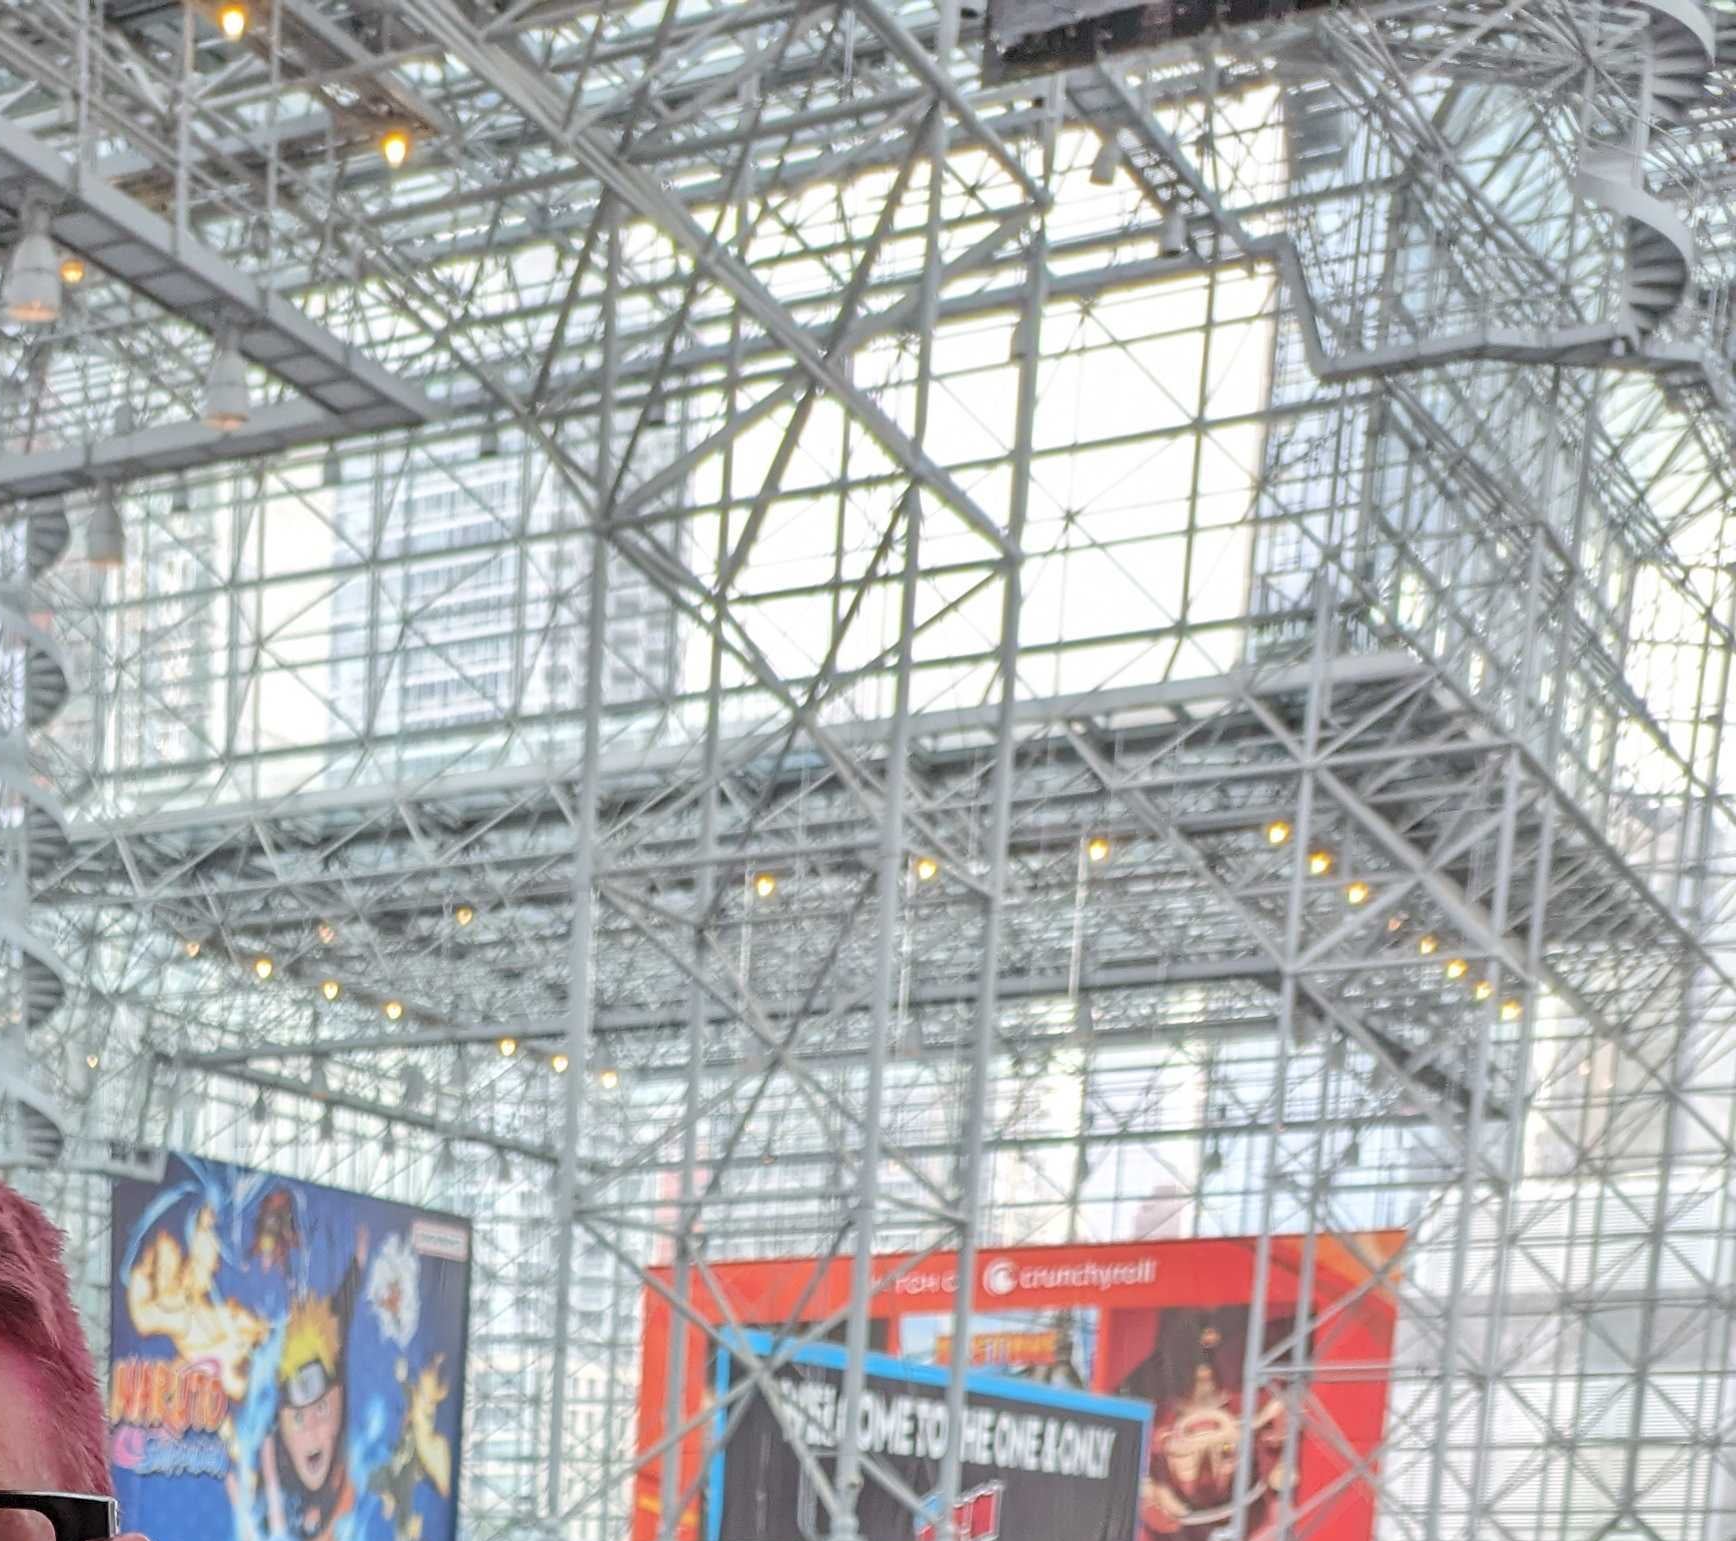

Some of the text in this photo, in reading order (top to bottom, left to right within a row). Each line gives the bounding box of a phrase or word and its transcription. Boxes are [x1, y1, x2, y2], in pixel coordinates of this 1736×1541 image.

[1019, 1259, 1158, 1291] crunchyroll
[916, 1401, 950, 1460] TO
[959, 1407, 995, 1465] HE
[995, 1411, 1042, 1472] ONE
[1059, 1421, 1117, 1480] ONLY
